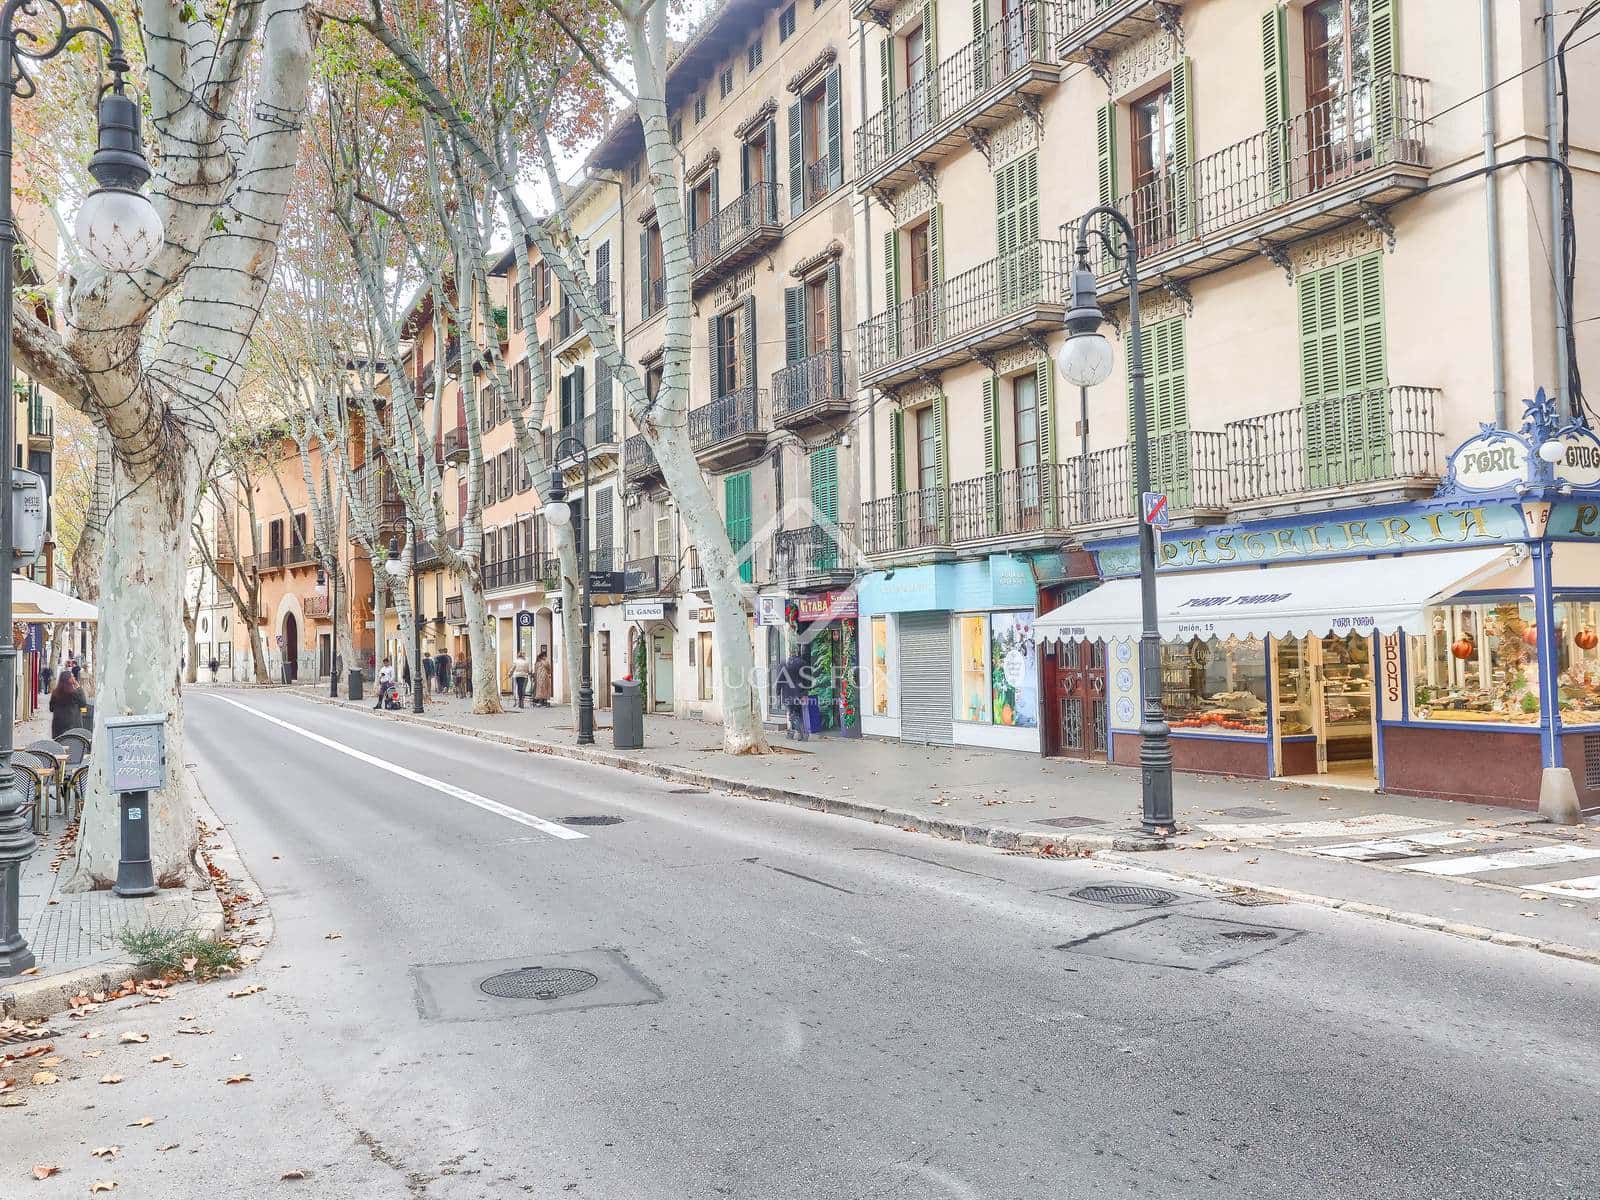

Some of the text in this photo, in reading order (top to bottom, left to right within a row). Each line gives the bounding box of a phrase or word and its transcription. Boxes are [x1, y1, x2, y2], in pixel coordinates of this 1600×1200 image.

[1159, 507, 1502, 568] PASTELERIA
[627, 608, 661, 616] EL GANSO
[1204, 623, 1215, 632] 15
